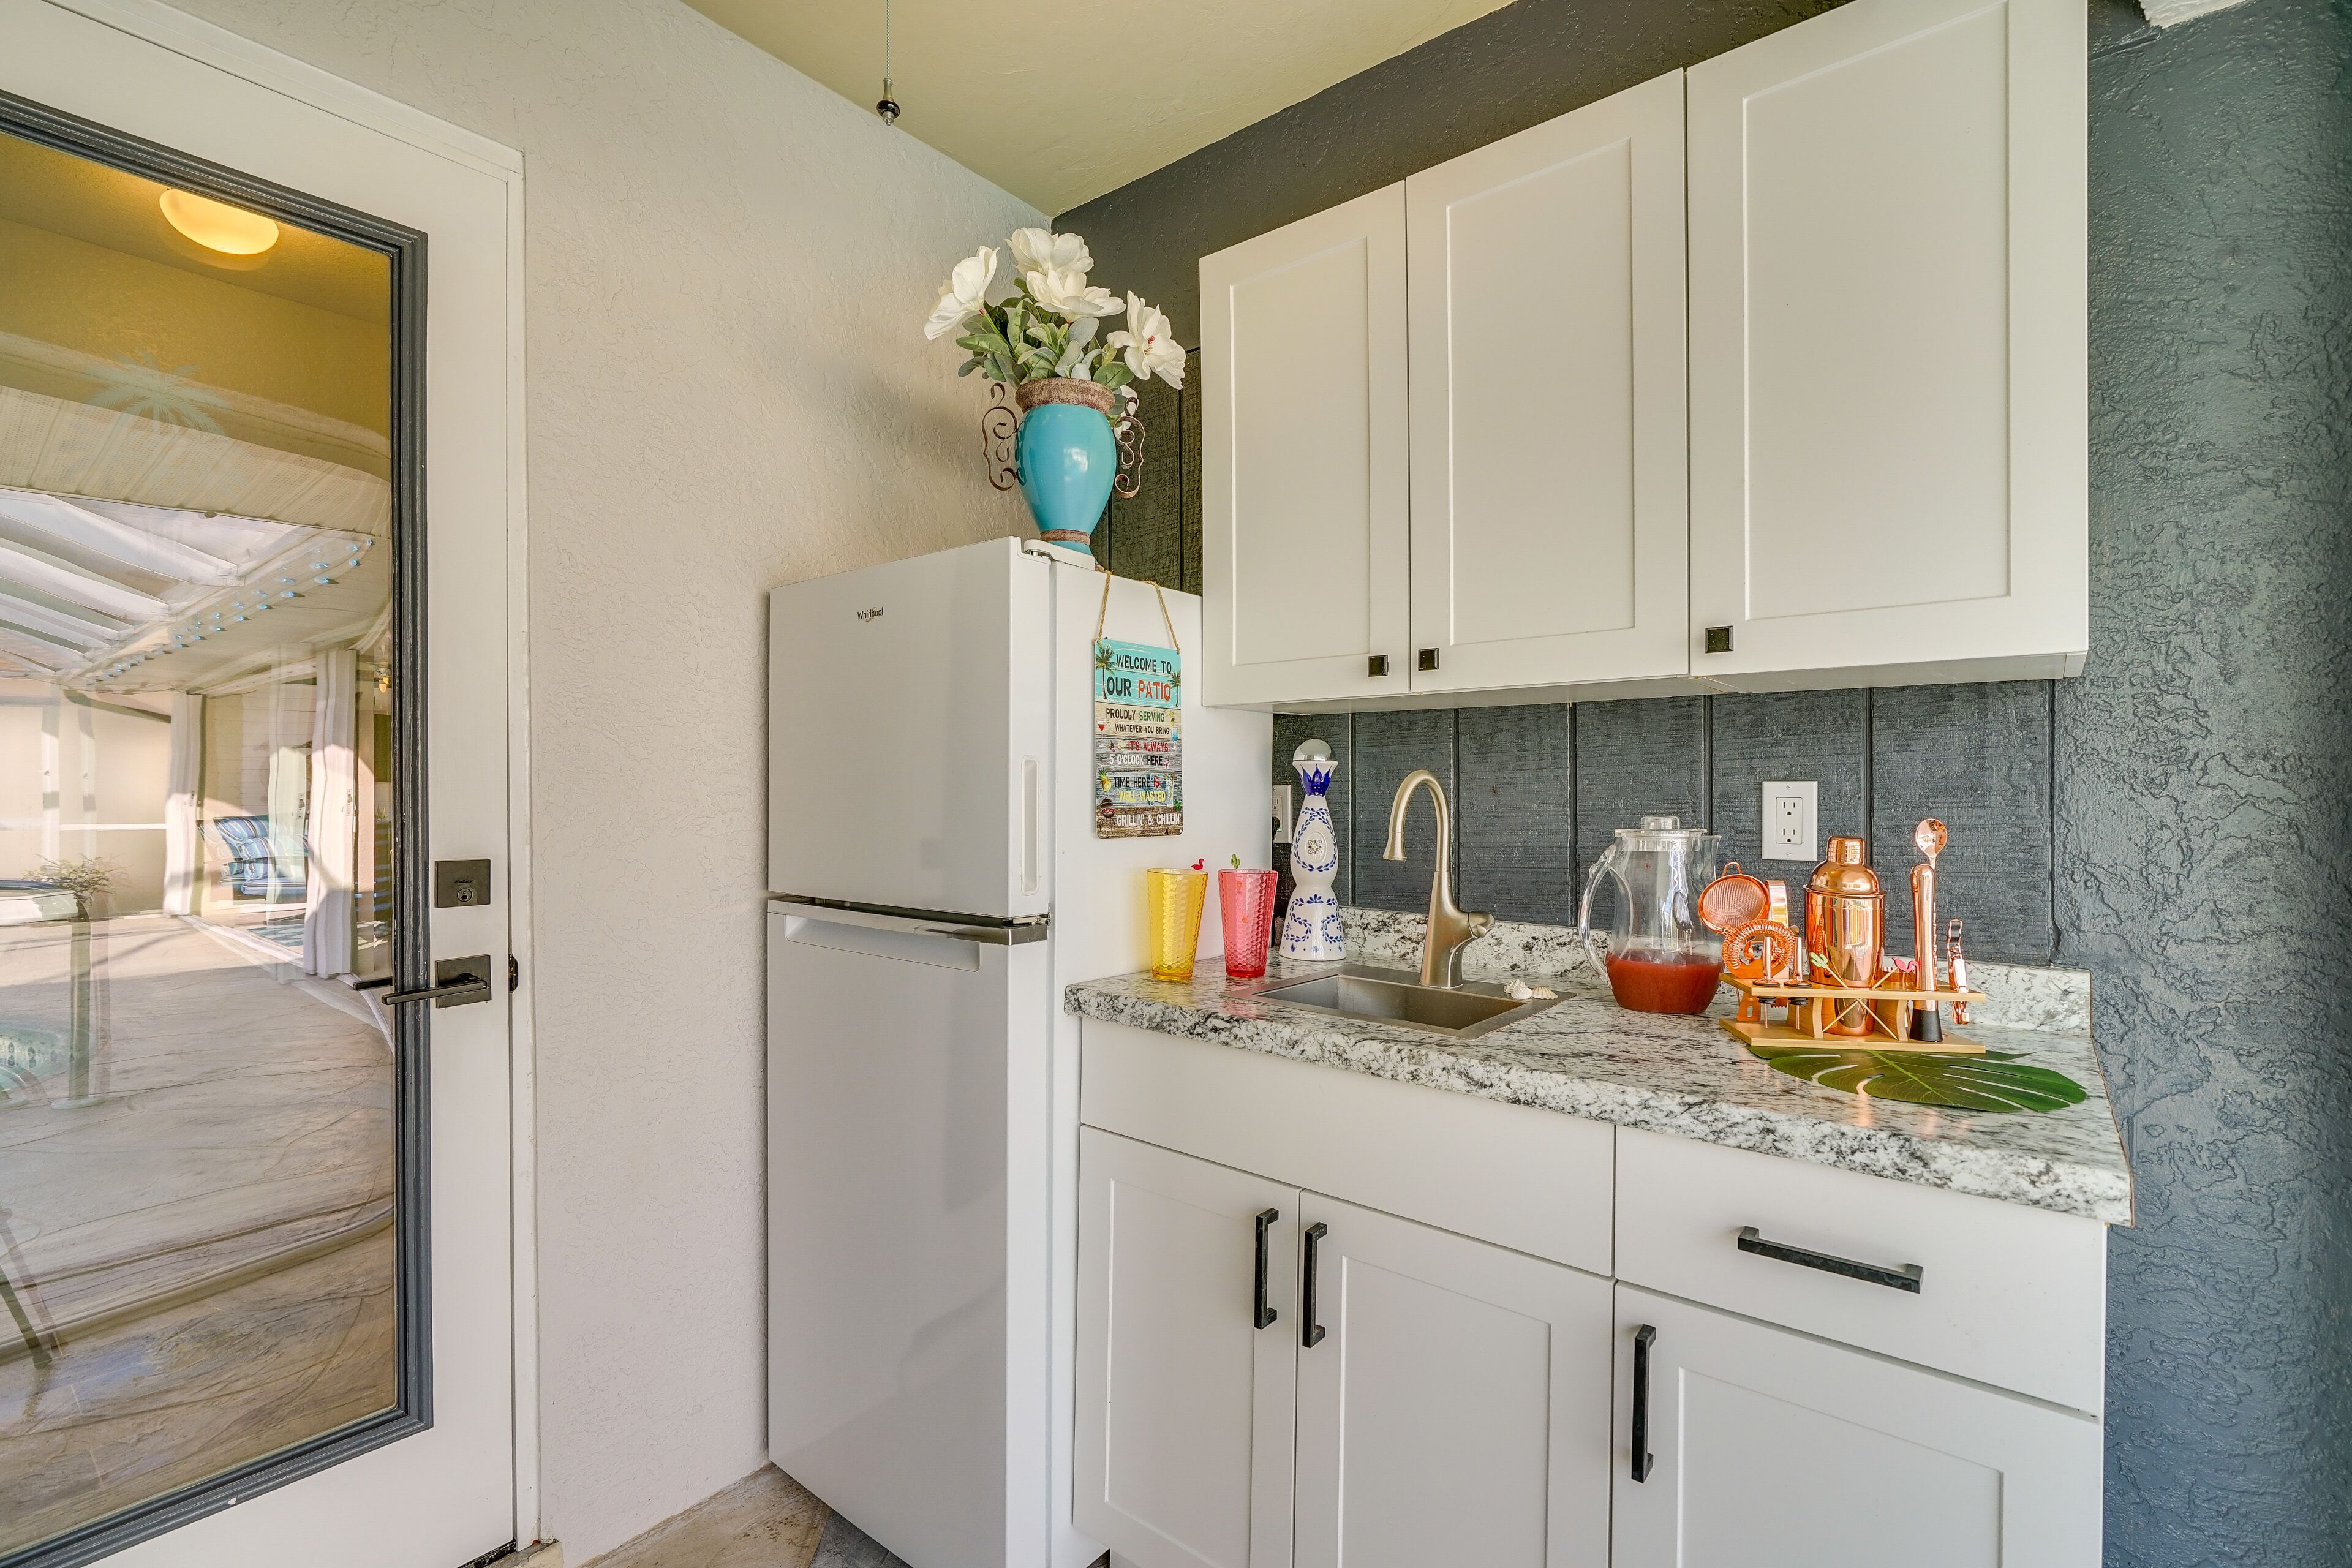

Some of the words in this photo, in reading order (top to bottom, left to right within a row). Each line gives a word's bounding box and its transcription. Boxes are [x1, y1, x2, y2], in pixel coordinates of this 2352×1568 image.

[857, 606, 883, 620] Whirlpool
[1116, 654, 1157, 673] WELCOME
[1161, 660, 1172, 674] TO
[1106, 676, 1132, 697] OUR
[1138, 679, 1171, 701] PATIO
[1106, 707, 1136, 720] PROUDLY
[1139, 710, 1165, 723] SERVING
[1115, 723, 1142, 733] WHATEVER
[1145, 726, 1154, 734] YOU
[1128, 741, 1140, 751] IT'S
[1143, 742, 1169, 752] ALWAYS
[1109, 754, 1114, 764] 5
[1117, 754, 1144, 765] O'CLOCK
[1147, 755, 1163, 766] HERE
[1114, 777, 1130, 788] TIME
[1133, 777, 1150, 788] HERE
[1153, 777, 1160, 788] IS
[1119, 791, 1137, 802] WELL
[1139, 791, 1166, 801] WASTED
[1117, 814, 1144, 827] GRILLIN'
[1147, 815, 1153, 826] &
[1156, 813, 1181, 826] CHILLIN'
